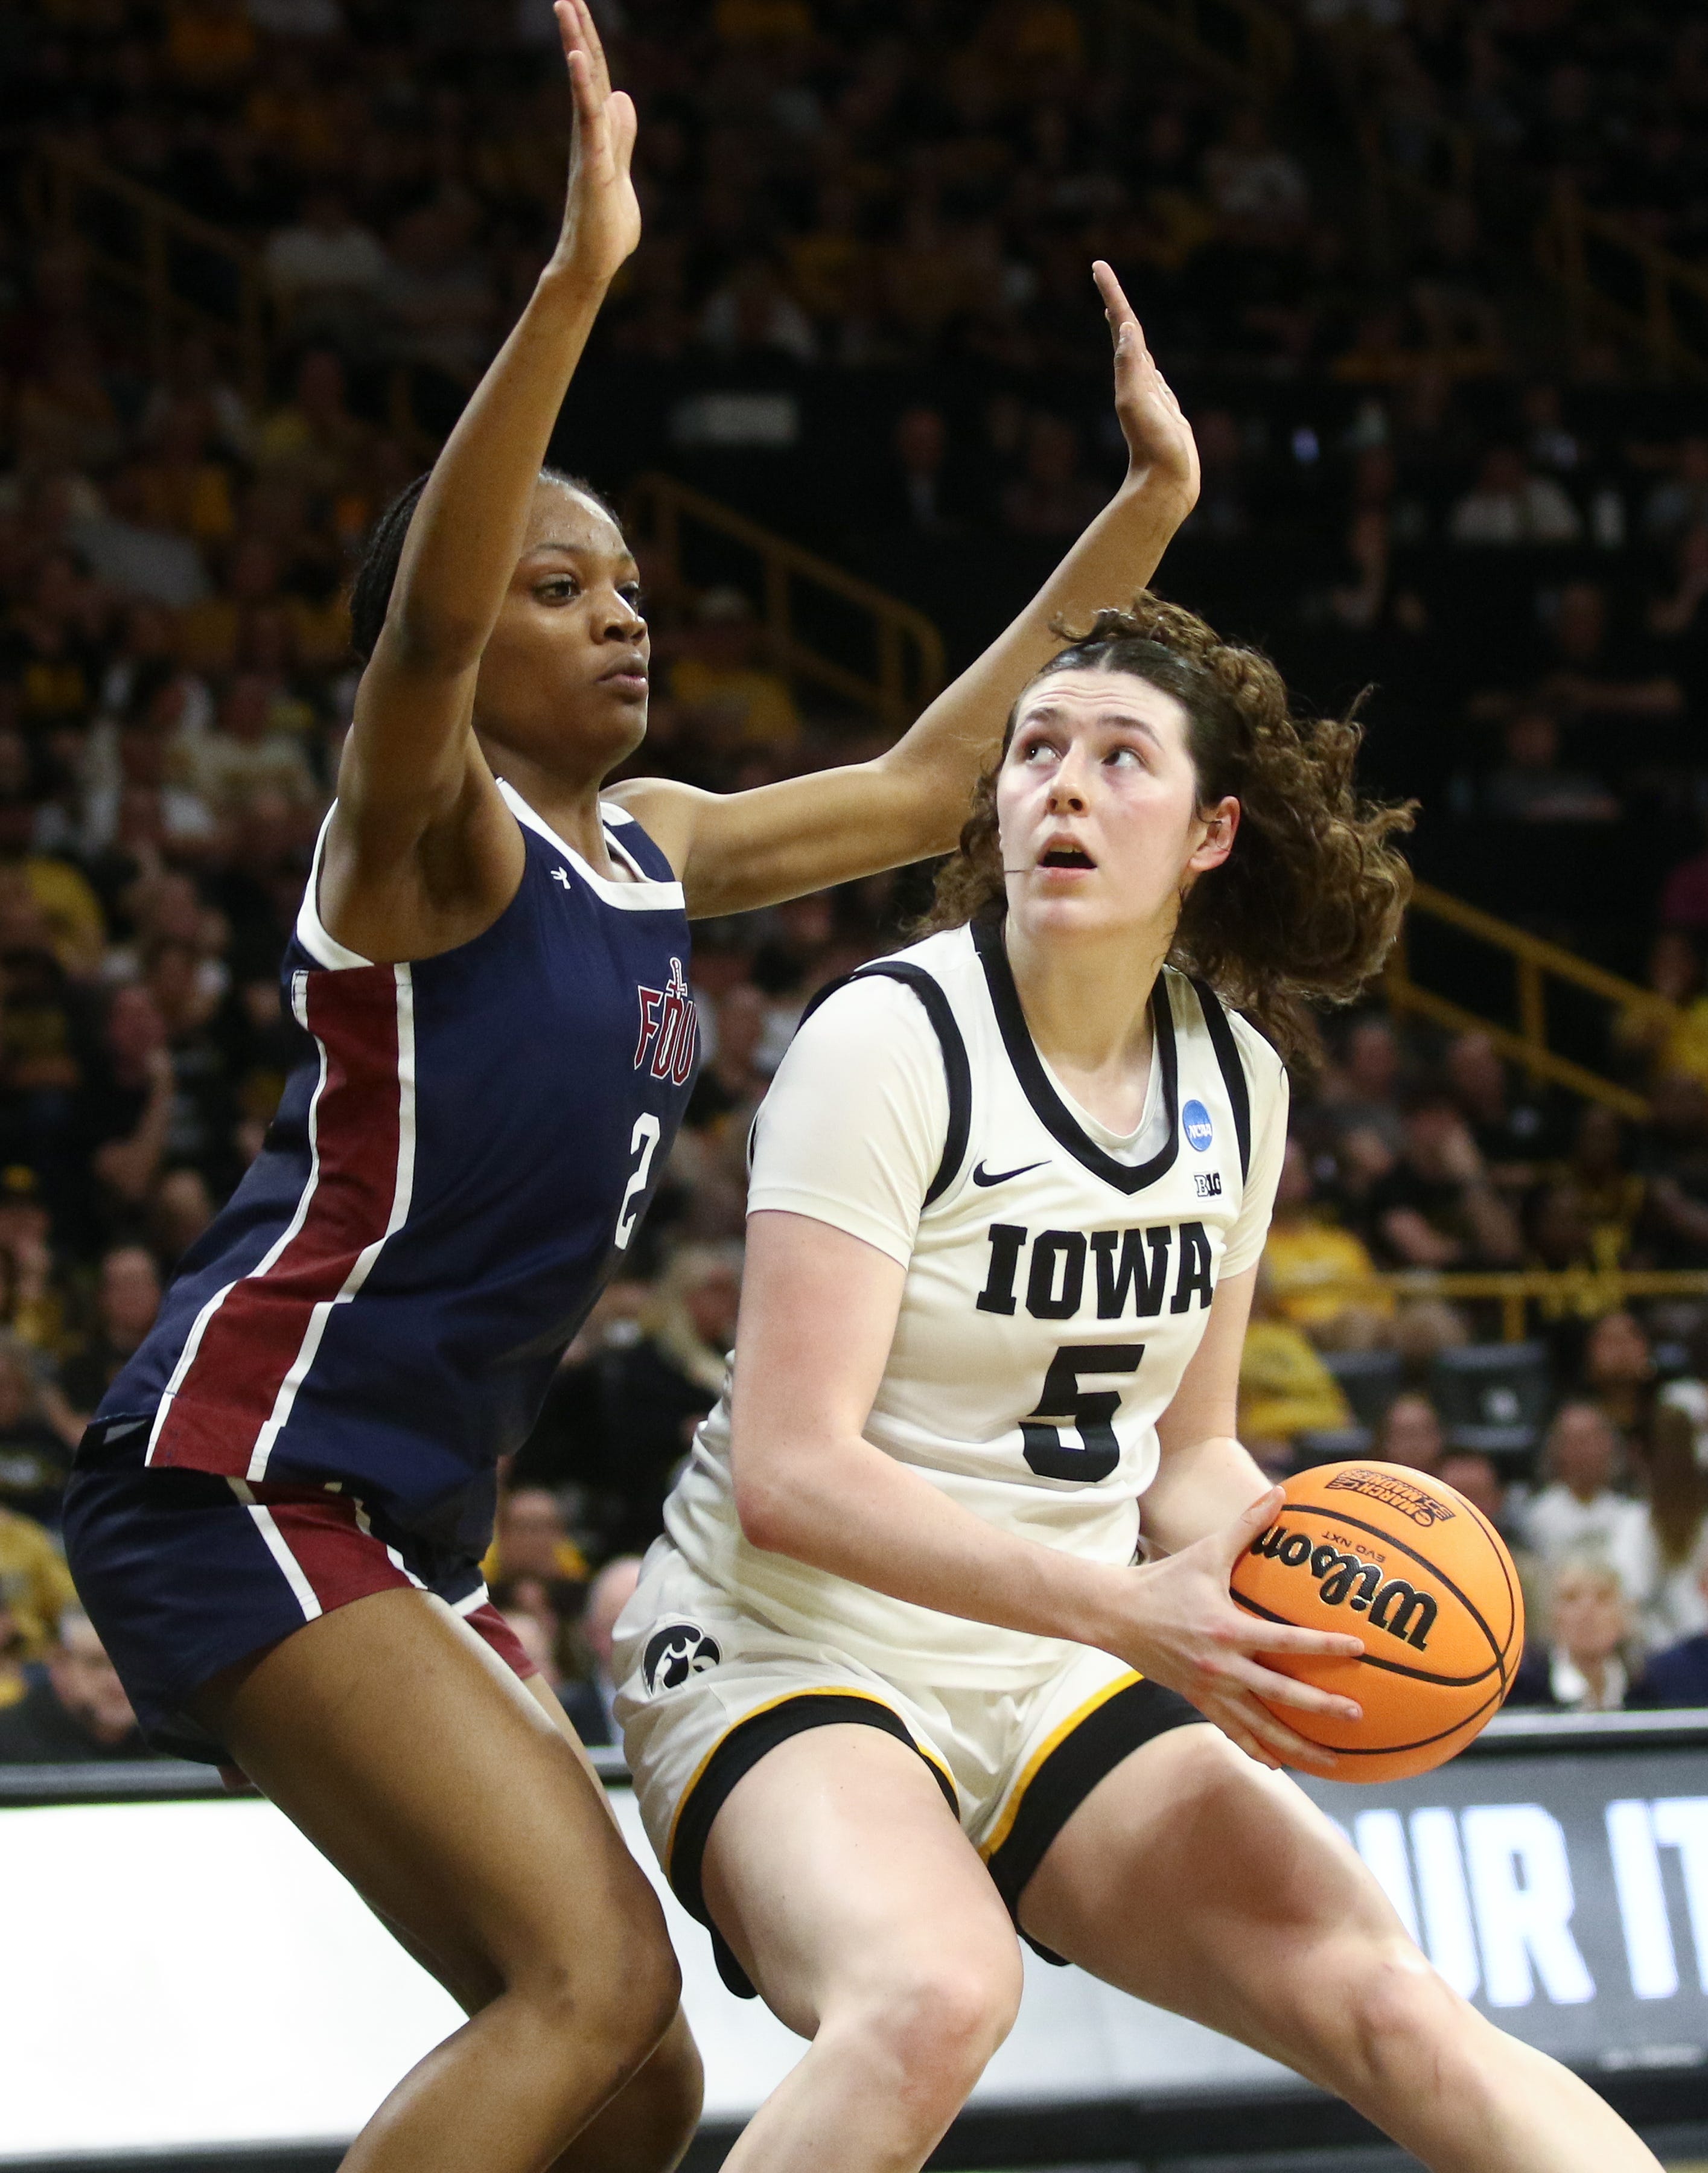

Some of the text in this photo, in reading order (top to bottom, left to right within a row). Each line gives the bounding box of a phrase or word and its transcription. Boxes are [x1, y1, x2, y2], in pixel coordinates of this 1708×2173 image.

[634, 984, 697, 1086] FDU
[614, 1112, 660, 1250] 2
[1188, 1123, 1212, 1138] NCAA
[976, 1222, 1213, 1319] IOWA
[1019, 1344, 1145, 1482] 5
[1251, 1526, 1439, 1652] Wilson
[1322, 1531, 1386, 1563] EVO NXT
[1327, 1804, 1596, 2007] UR
